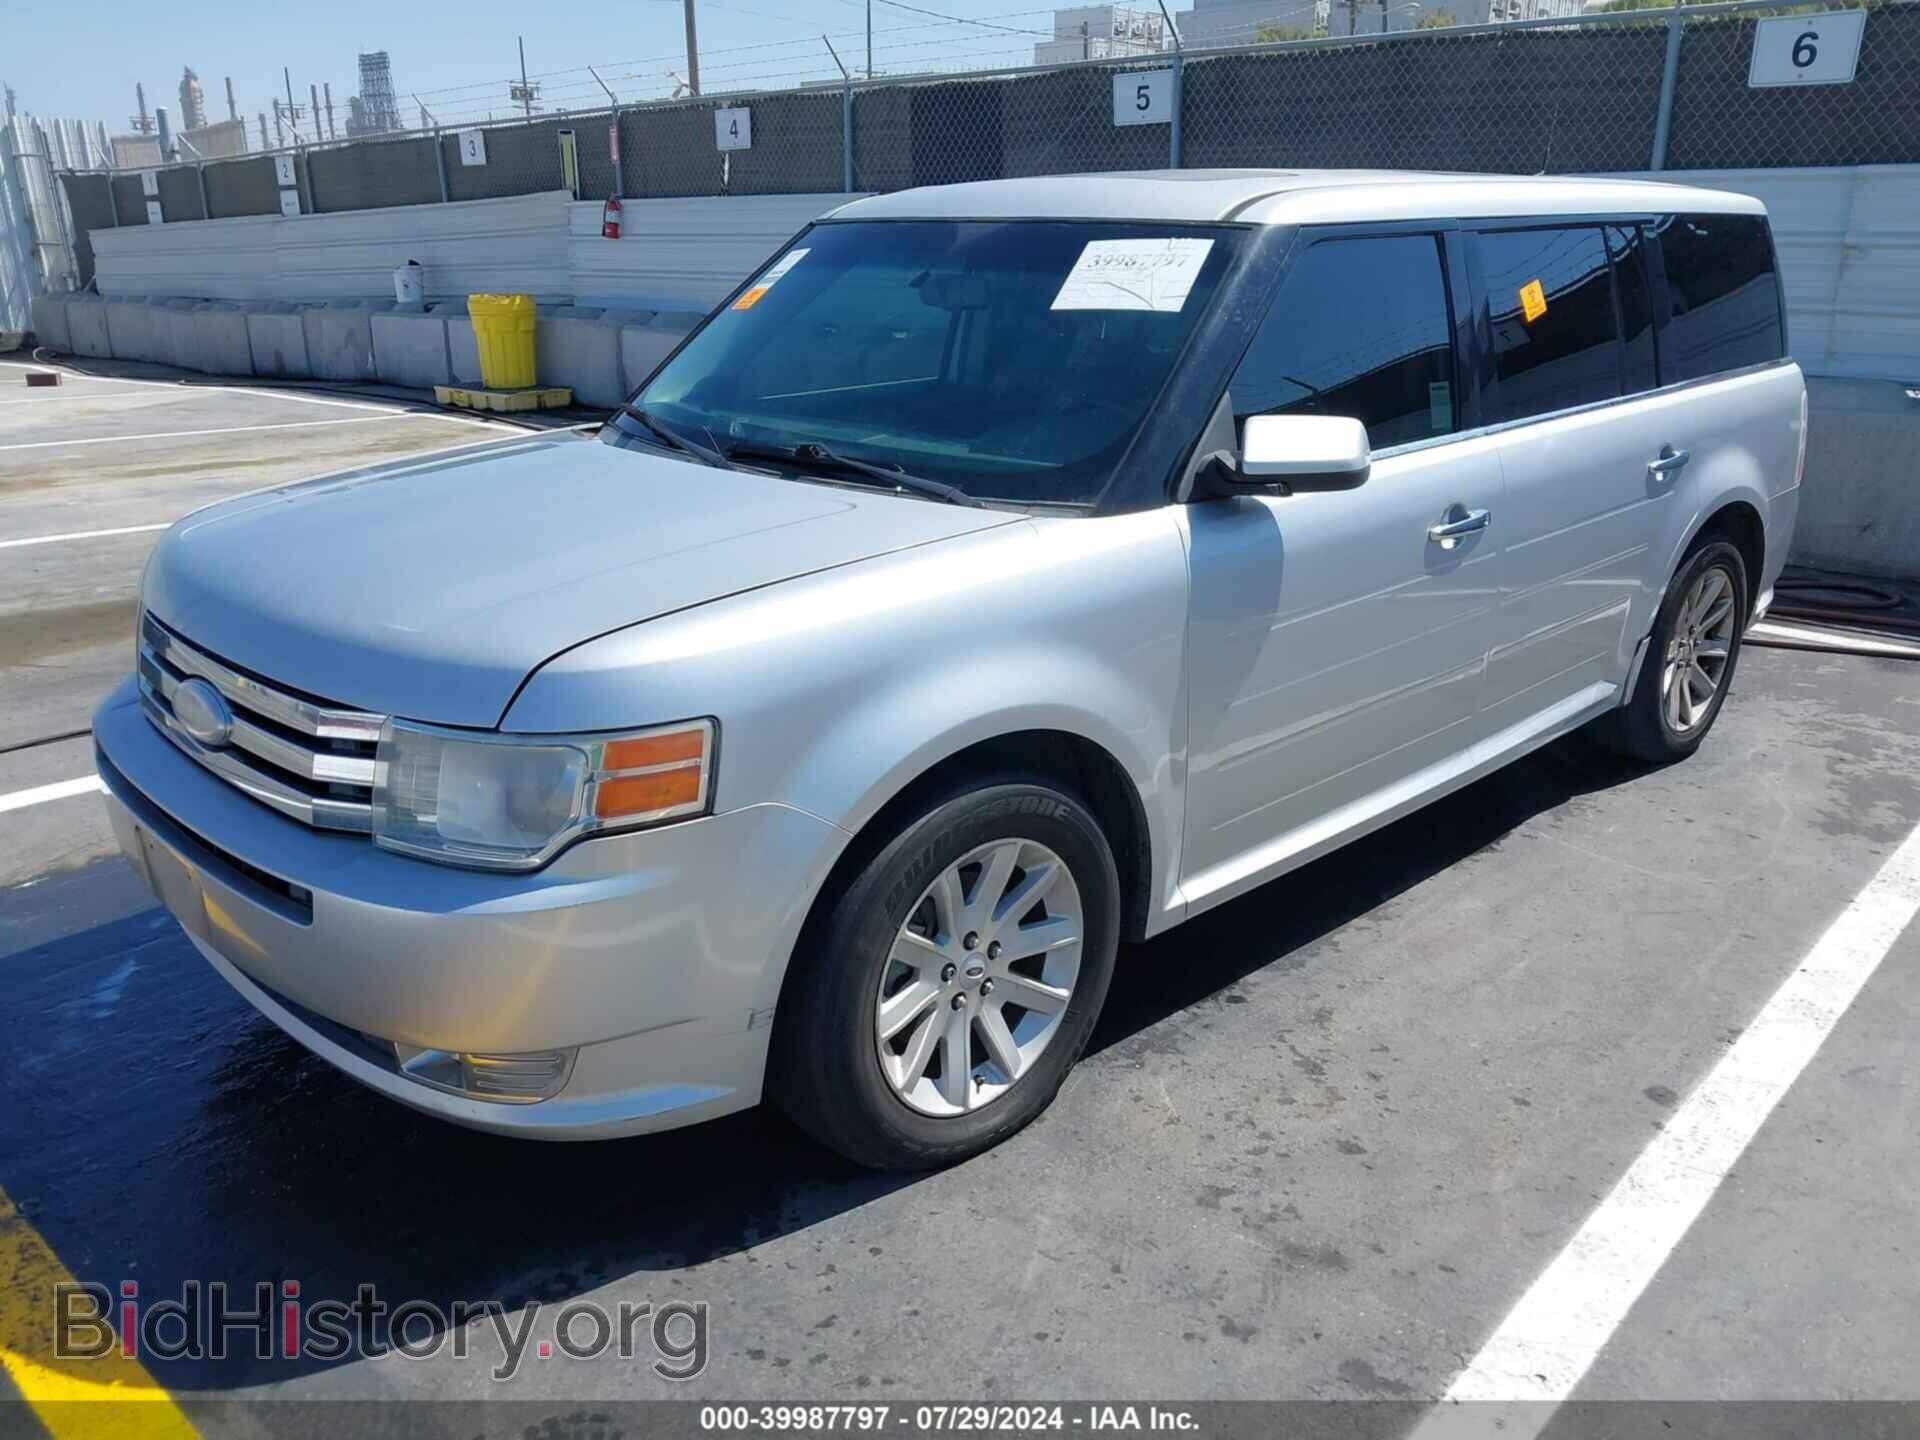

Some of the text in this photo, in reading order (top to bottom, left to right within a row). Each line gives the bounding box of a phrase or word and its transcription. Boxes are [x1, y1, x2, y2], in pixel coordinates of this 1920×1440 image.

[1792, 31, 1819, 68] 6
[1136, 85, 1150, 111] 5
[729, 119, 738, 139] 4
[469, 140, 476, 157] 3
[282, 163, 289, 178] 2
